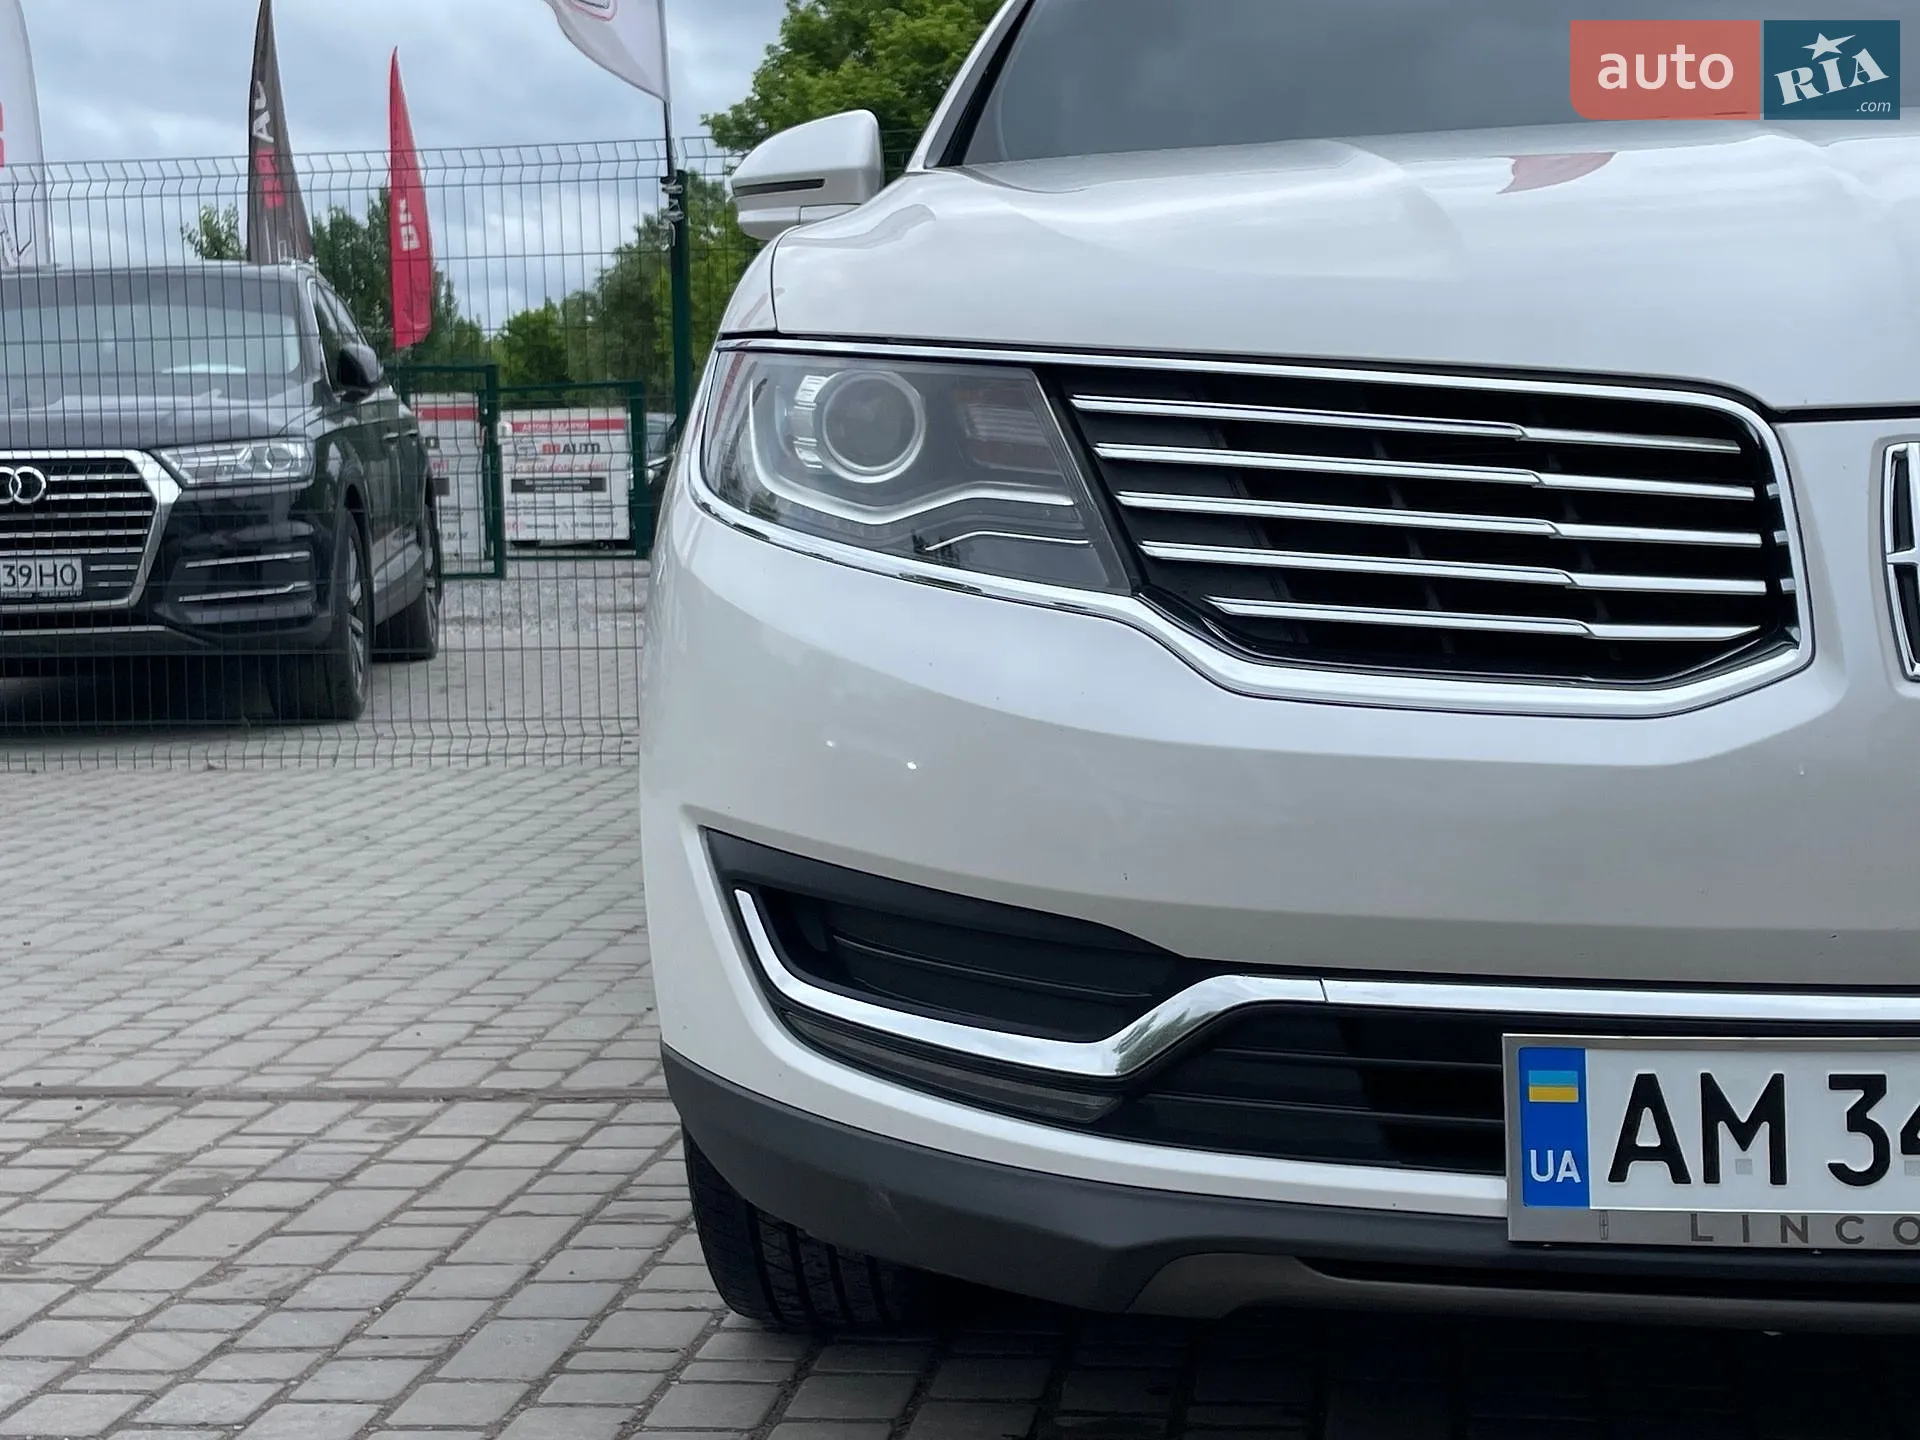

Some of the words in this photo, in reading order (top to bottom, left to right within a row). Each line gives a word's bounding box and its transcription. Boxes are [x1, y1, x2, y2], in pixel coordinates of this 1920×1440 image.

[1607, 1072, 1788, 1186] AM
[1530, 1150, 1581, 1183] UA
[1690, 1212, 1920, 1246] LINCO
